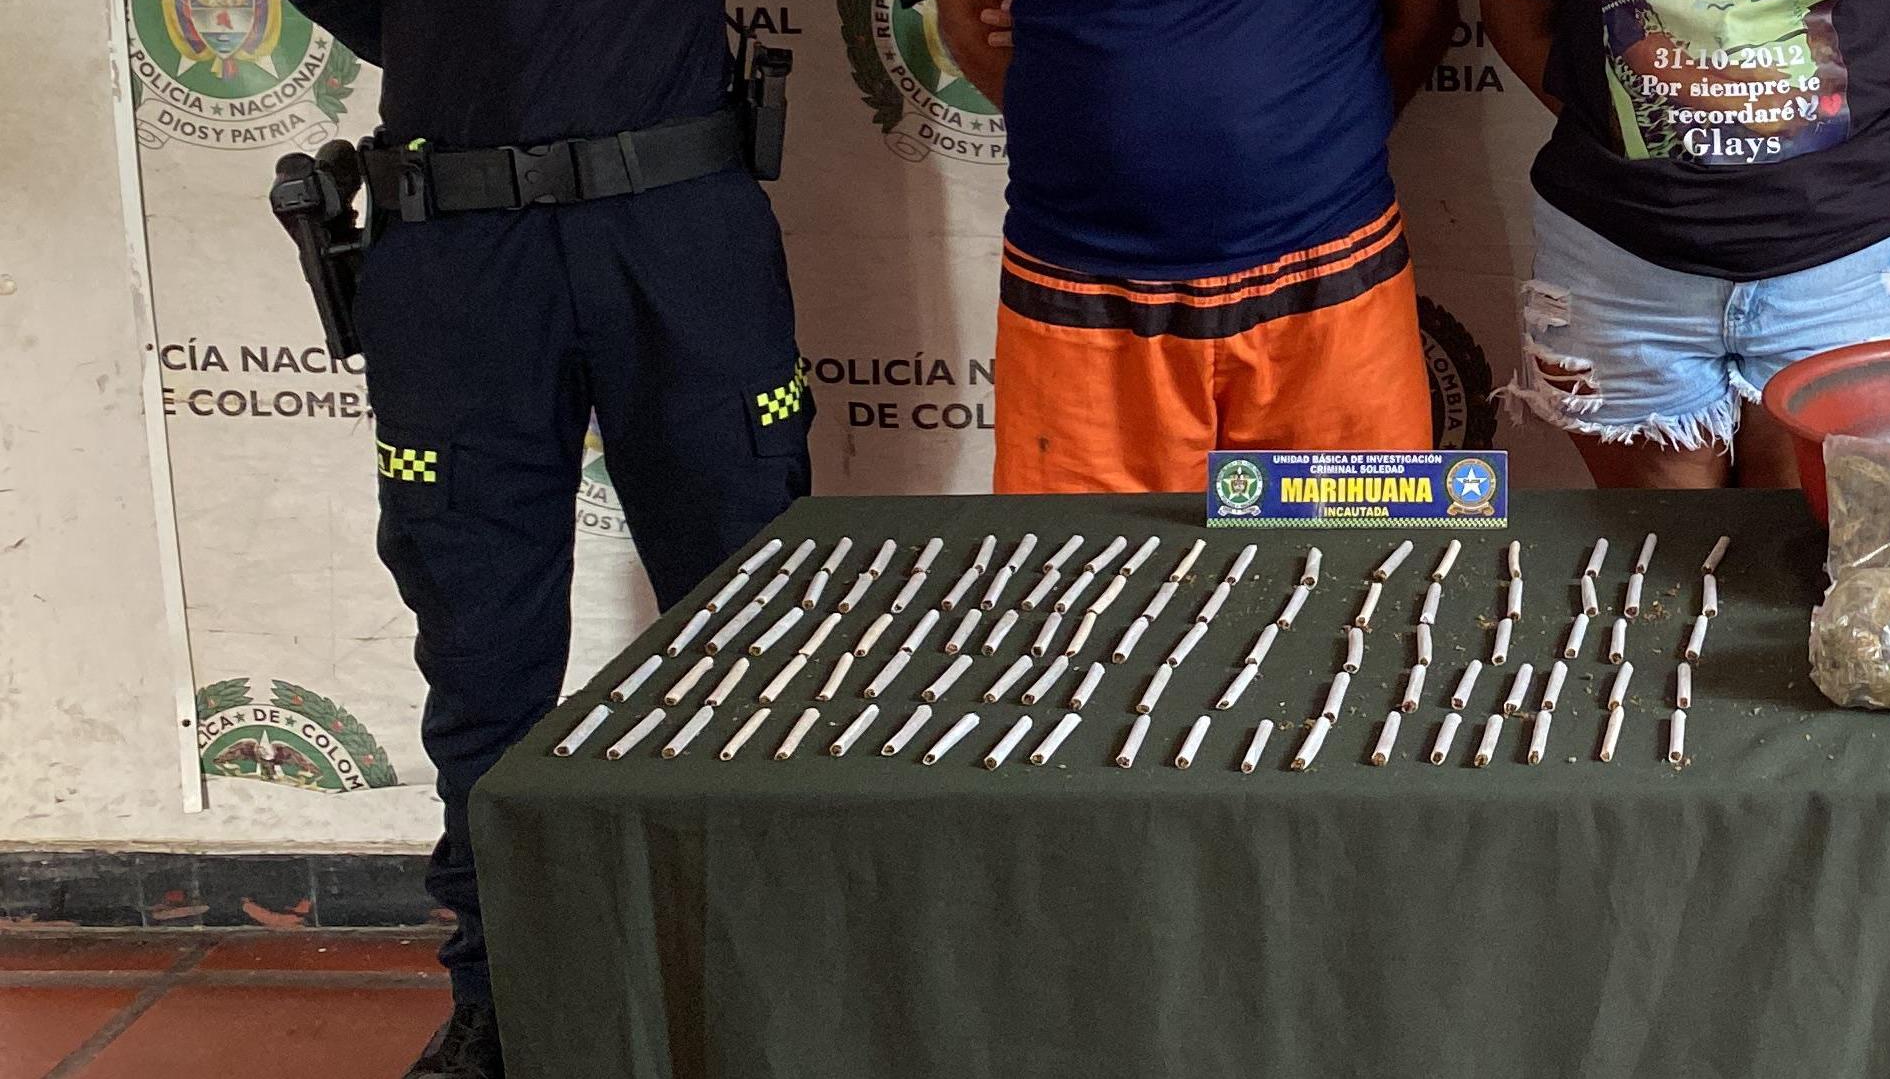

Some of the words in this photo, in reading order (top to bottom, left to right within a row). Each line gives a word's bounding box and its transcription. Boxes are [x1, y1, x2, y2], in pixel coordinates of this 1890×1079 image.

[1654, 43, 1805, 71] 31-10-2012
[229, 52, 327, 117] NACIONAL
[1641, 73, 1682, 98] Por
[1689, 76, 1790, 104] siempre
[1798, 71, 1821, 93] te
[158, 109, 209, 142] DIOS
[210, 127, 224, 143] Y
[231, 113, 306, 143] PATRIA
[1668, 100, 1796, 126] recordaré
[918, 123, 967, 154] DIOS
[968, 143, 984, 158] Y
[1682, 127, 1782, 164] Glays
[240, 346, 366, 375] NACIO
[1423, 342, 1463, 431] LOMBIA
[188, 389, 364, 418] COLOMB
[848, 401, 900, 429] DE
[1273, 455, 1310, 464] UNIDAD
[1312, 453, 1348, 464] BÁSICA
[1350, 455, 1364, 464] DE
[1366, 453, 1442, 465] INVESTIGACIÓN
[1310, 465, 1358, 474] CRIMINAL
[1360, 465, 1405, 474] SOLEDAD
[1281, 477, 1433, 503] MARIHUANA
[1323, 506, 1389, 518] INCAUTADA
[253, 708, 279, 723] DE
[301, 723, 364, 791] COLOM
